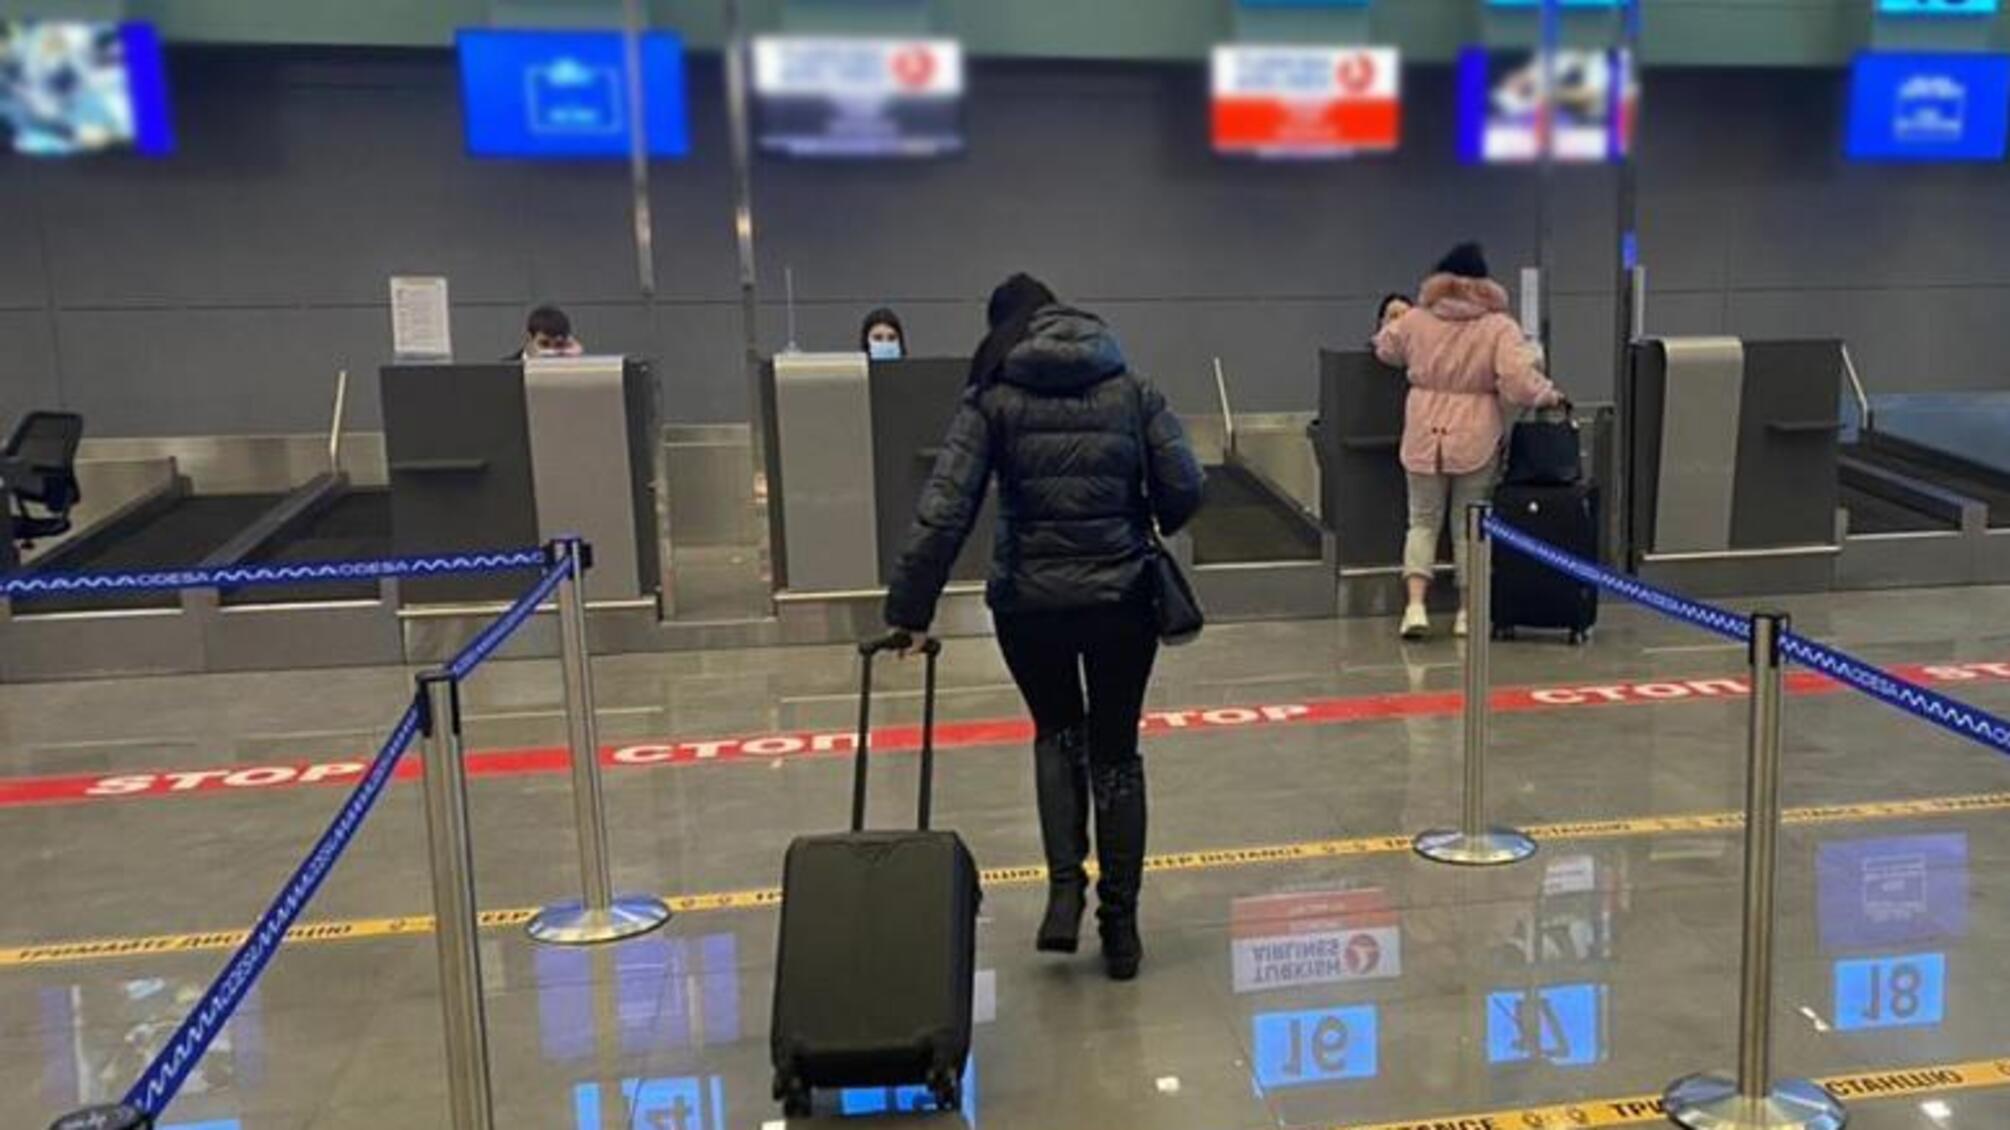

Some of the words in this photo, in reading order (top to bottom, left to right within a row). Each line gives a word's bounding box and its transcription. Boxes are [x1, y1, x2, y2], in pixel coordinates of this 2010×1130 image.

[1847, 666, 1899, 698] ODESA
[1138, 704, 1309, 729] TOP
[86, 762, 367, 795] STOP
[1824, 1071, 1964, 1098] СТАНЦІЮ
